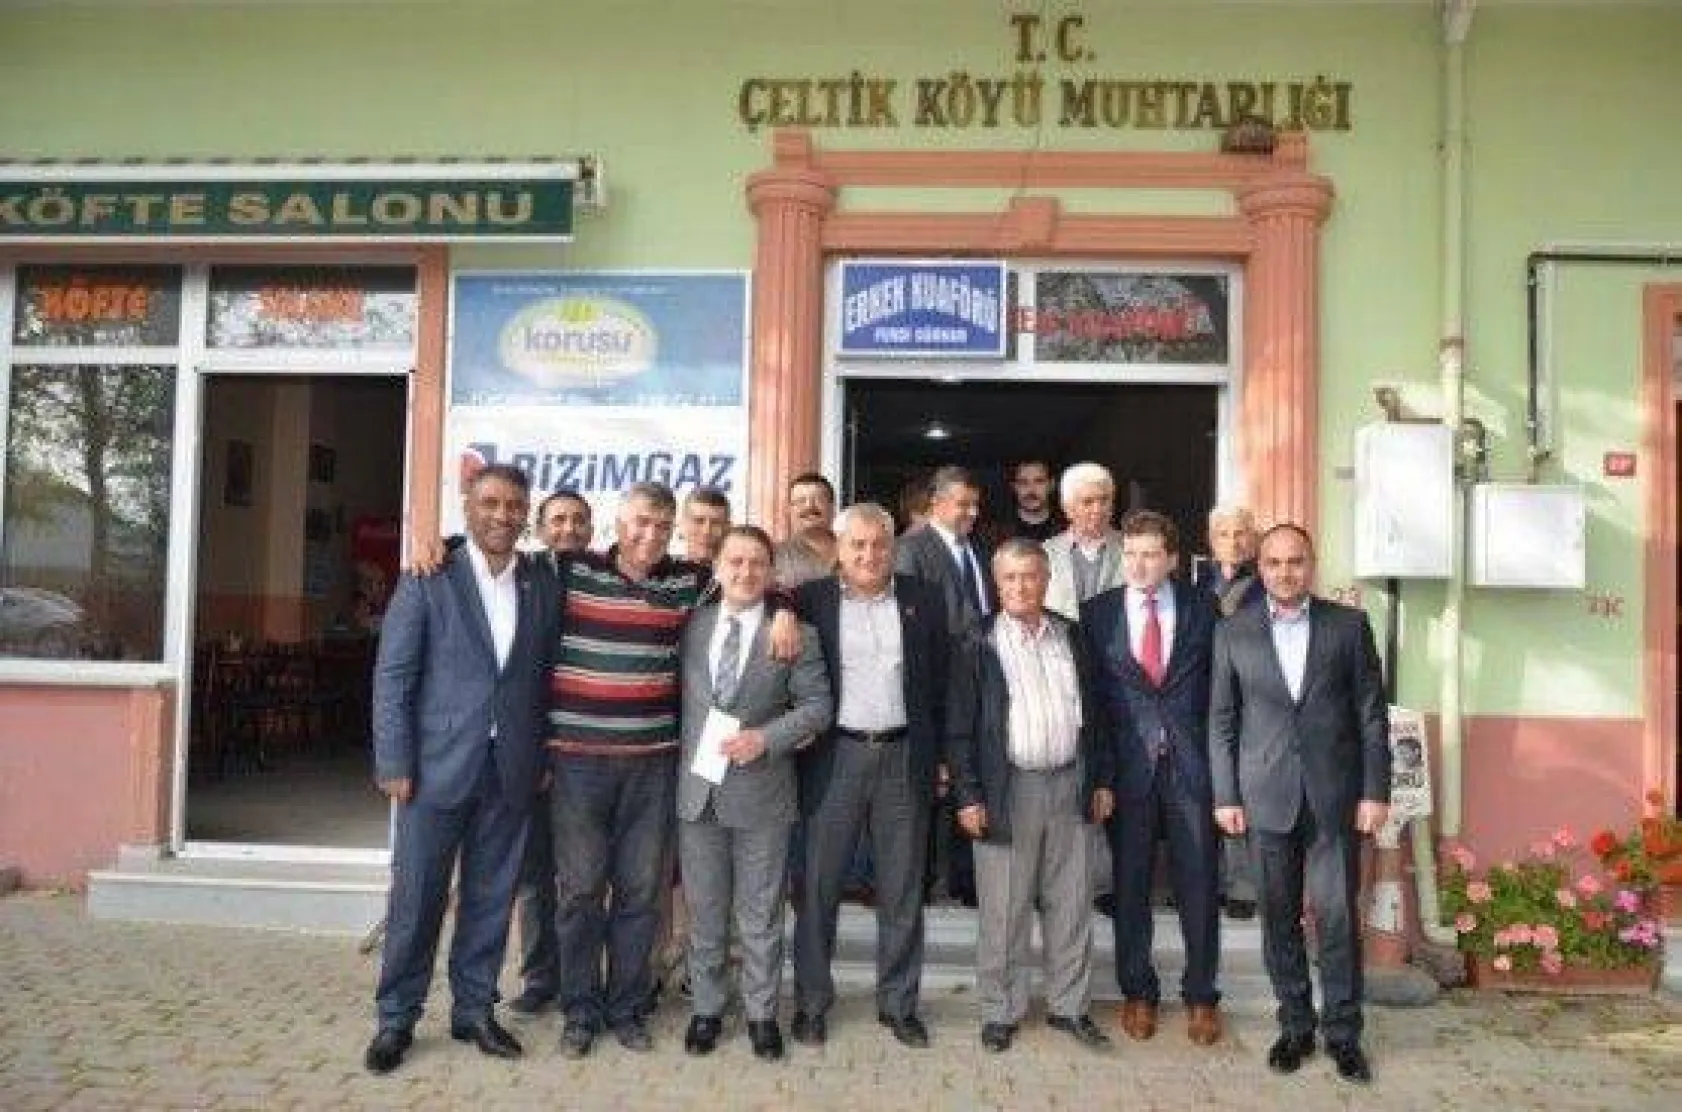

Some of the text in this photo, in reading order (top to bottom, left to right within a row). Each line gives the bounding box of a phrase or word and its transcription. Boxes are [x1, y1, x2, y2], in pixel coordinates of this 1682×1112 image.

[739, 70, 1353, 132] ÇELTİK KÖYÜ MUHTARLIĞI
[0, 187, 533, 225] KÖFTE SALONU
